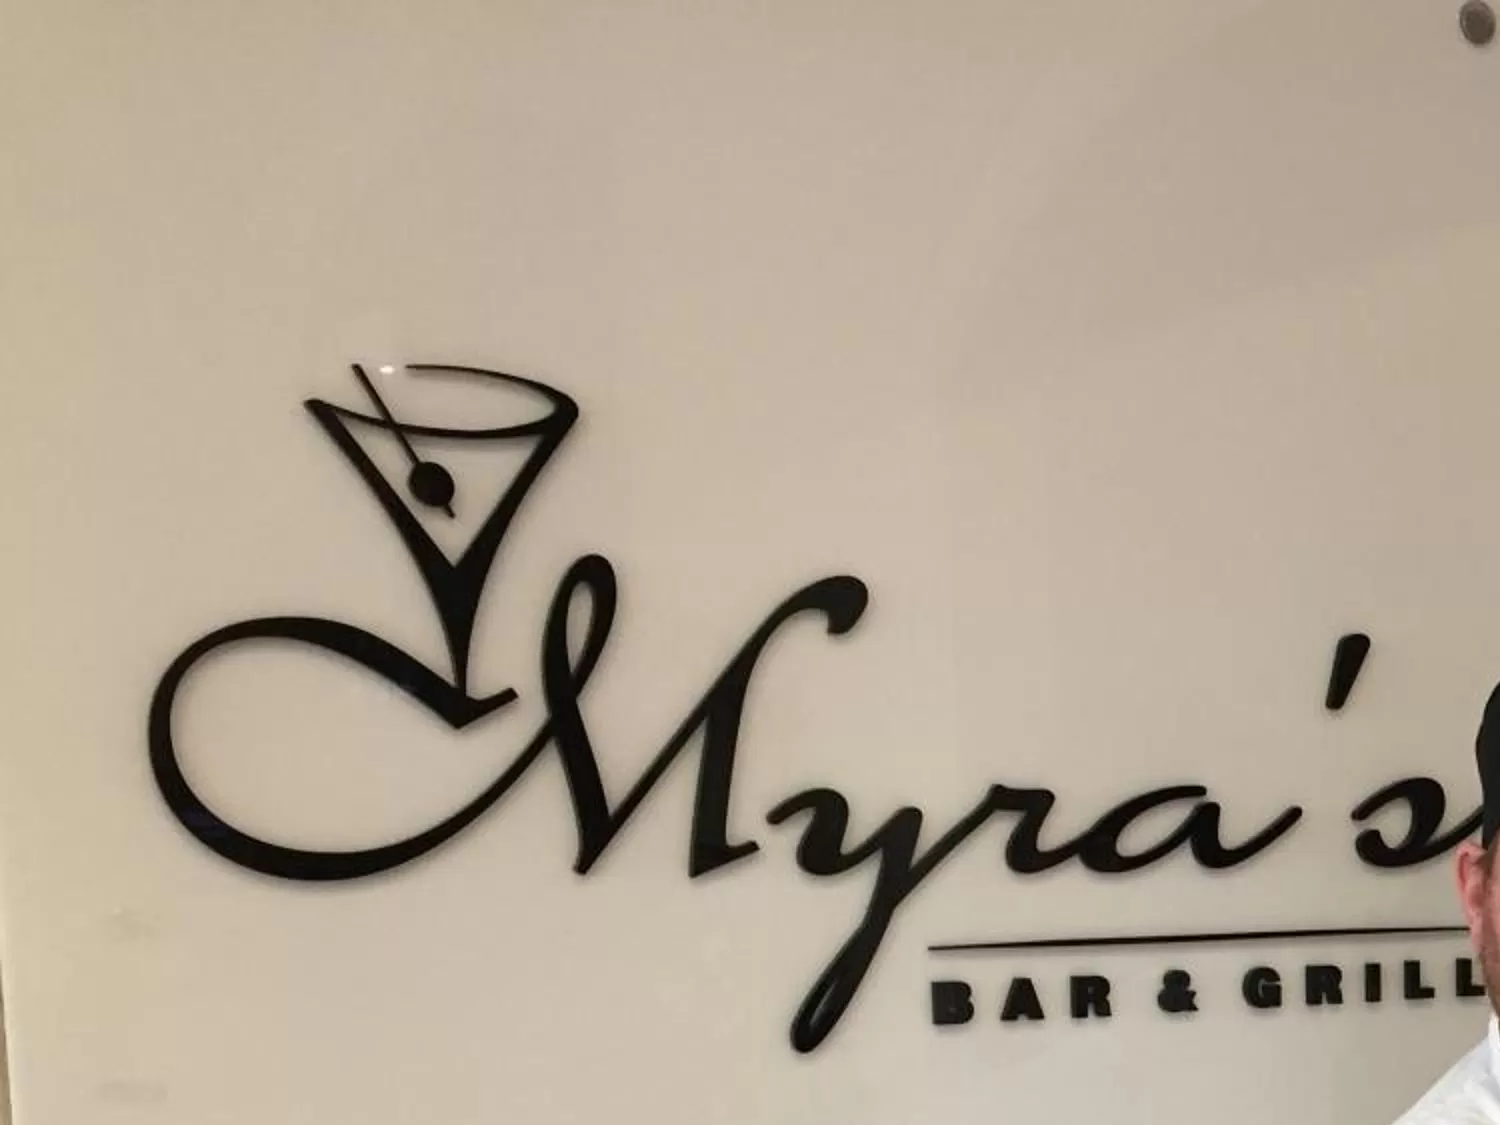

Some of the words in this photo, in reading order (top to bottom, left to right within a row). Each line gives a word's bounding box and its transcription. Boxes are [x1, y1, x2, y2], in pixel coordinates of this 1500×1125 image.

[148, 553, 1484, 1055] Myra's
[930, 974, 1113, 1026] BAR
[1156, 969, 1199, 1013] &
[1242, 957, 1487, 1008] GRILL
